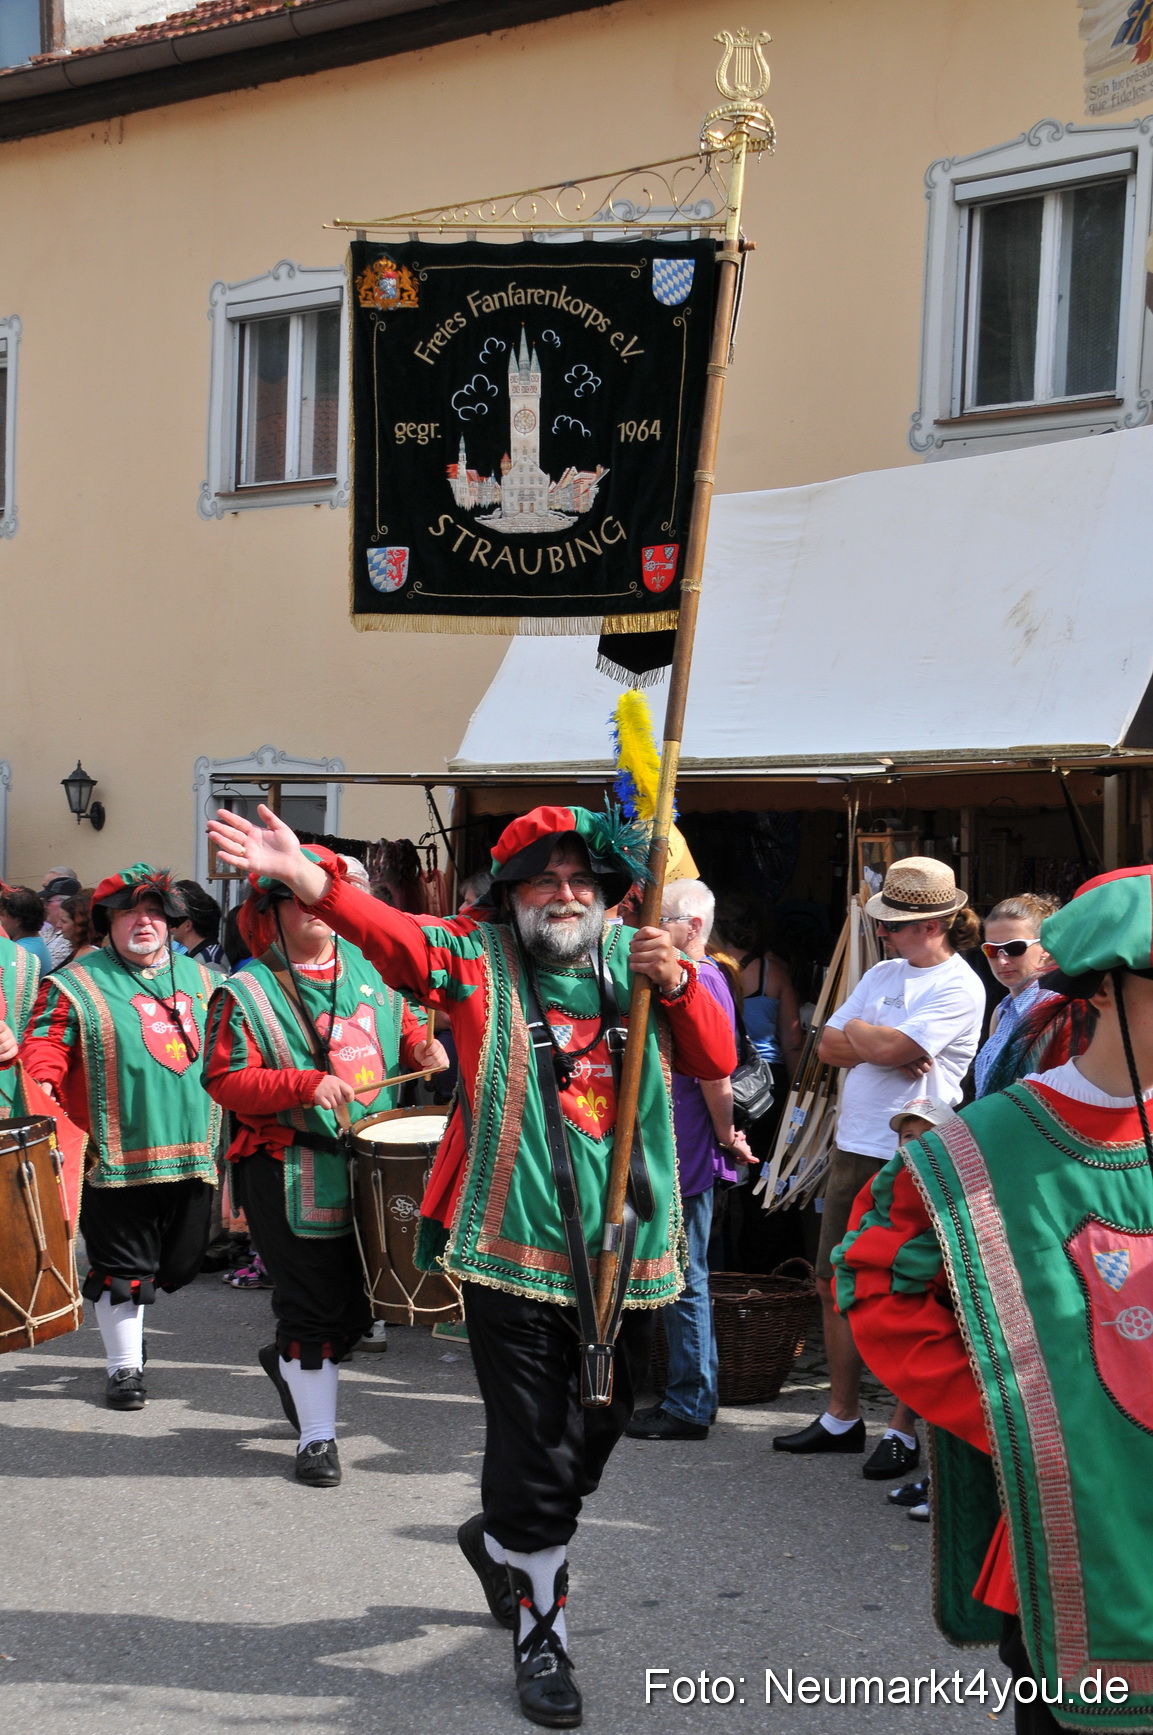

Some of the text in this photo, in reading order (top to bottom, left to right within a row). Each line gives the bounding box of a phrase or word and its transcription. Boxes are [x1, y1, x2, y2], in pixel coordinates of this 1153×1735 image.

[1089, 100, 1108, 115] que
[413, 311, 467, 366] Freies
[466, 281, 612, 333] Fanfarenkorps
[394, 419, 662, 445] gegr. 1964
[428, 513, 627, 576] STRAUBING
